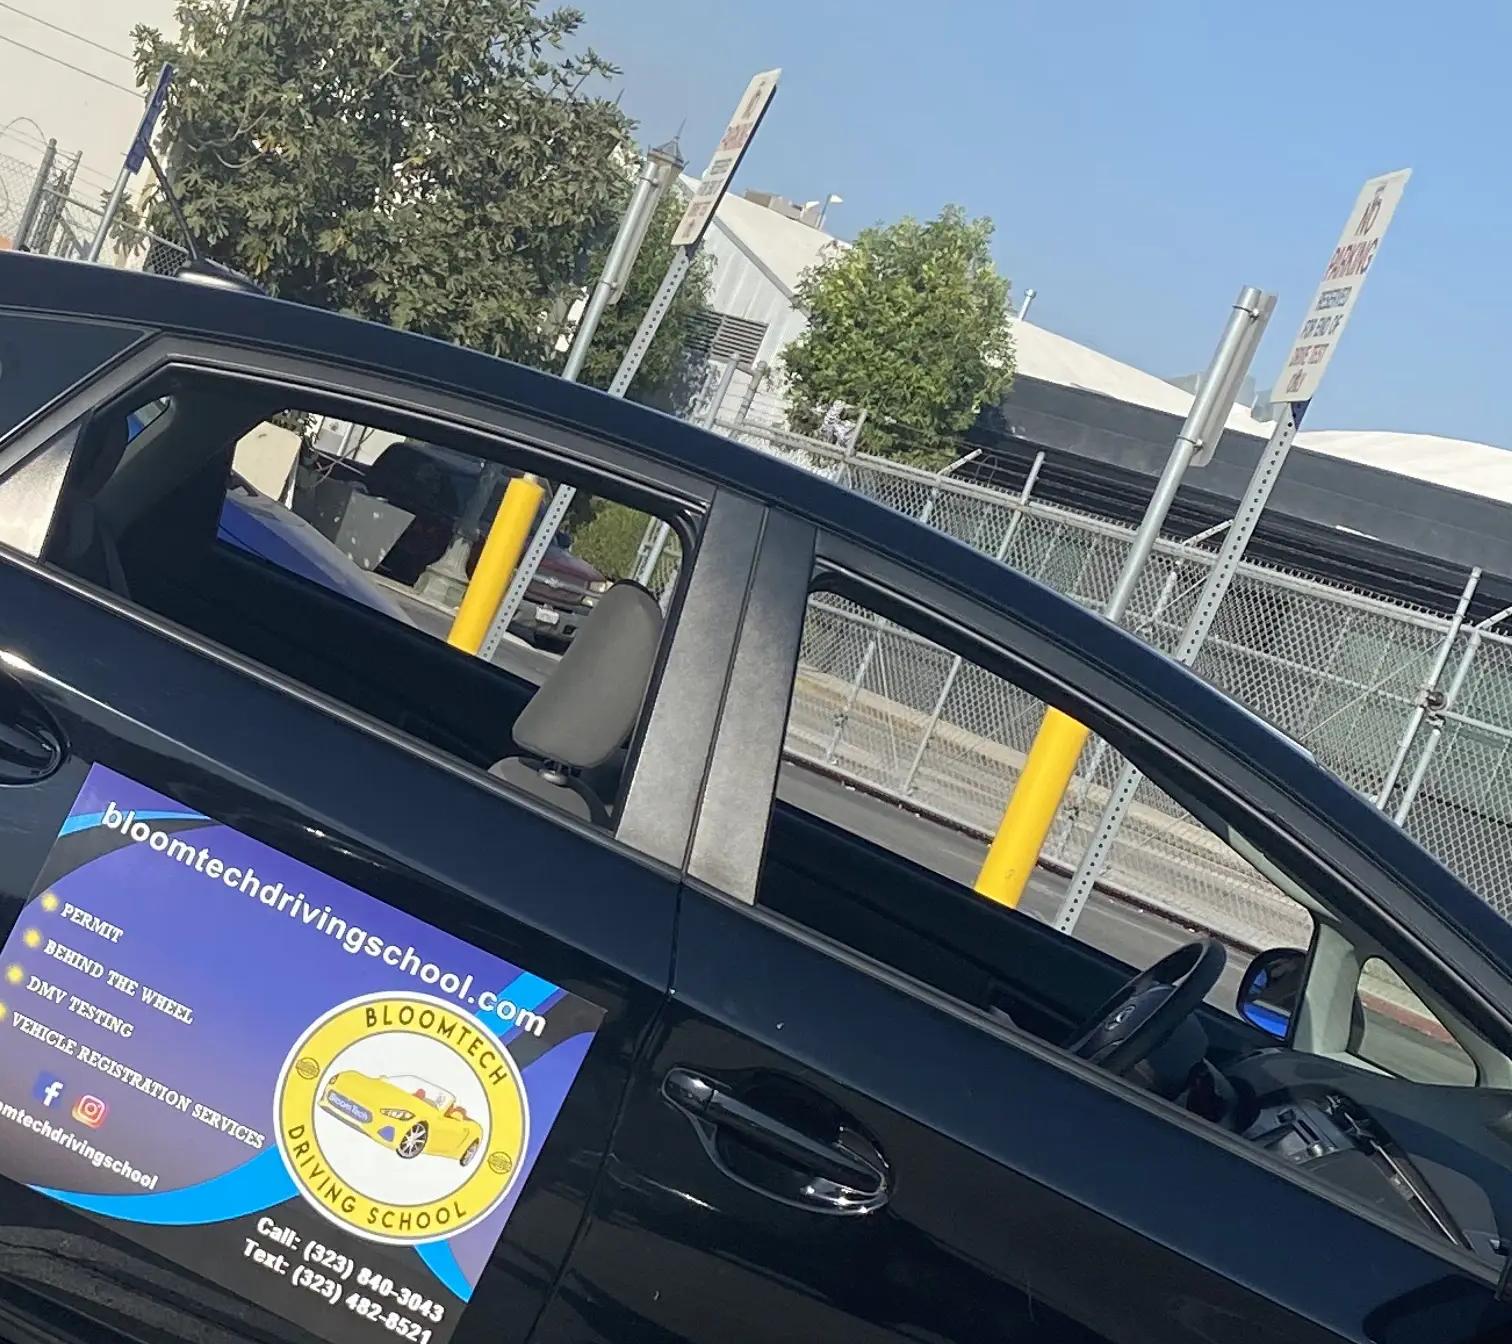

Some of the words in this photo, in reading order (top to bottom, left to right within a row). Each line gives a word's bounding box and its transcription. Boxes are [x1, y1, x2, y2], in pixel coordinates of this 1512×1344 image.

[61, 902, 124, 943] PERMIT
[101, 801, 548, 1037] bloomtechdrivingschool.com
[26, 975, 67, 1004] DMV
[69, 995, 134, 1038] TESTING
[43, 939, 104, 979] BEHIND
[107, 969, 139, 996] THE
[141, 986, 195, 1025] WHEEL
[12, 1011, 78, 1055] VEHICLE
[76, 1045, 192, 1113] REGISTRATION
[191, 1103, 266, 1149] SERVICES
[365, 1005, 508, 1086] BLOOMTECH
[288, 1124, 357, 1214] DRIVING
[366, 1200, 467, 1231] SCHOOL
[242, 1238, 290, 1275] Text:
[291, 1264, 343, 1305] (323)
[256, 1217, 303, 1251] Call:
[303, 1240, 354, 1280] (323)
[356, 1267, 445, 1323] 840-3043
